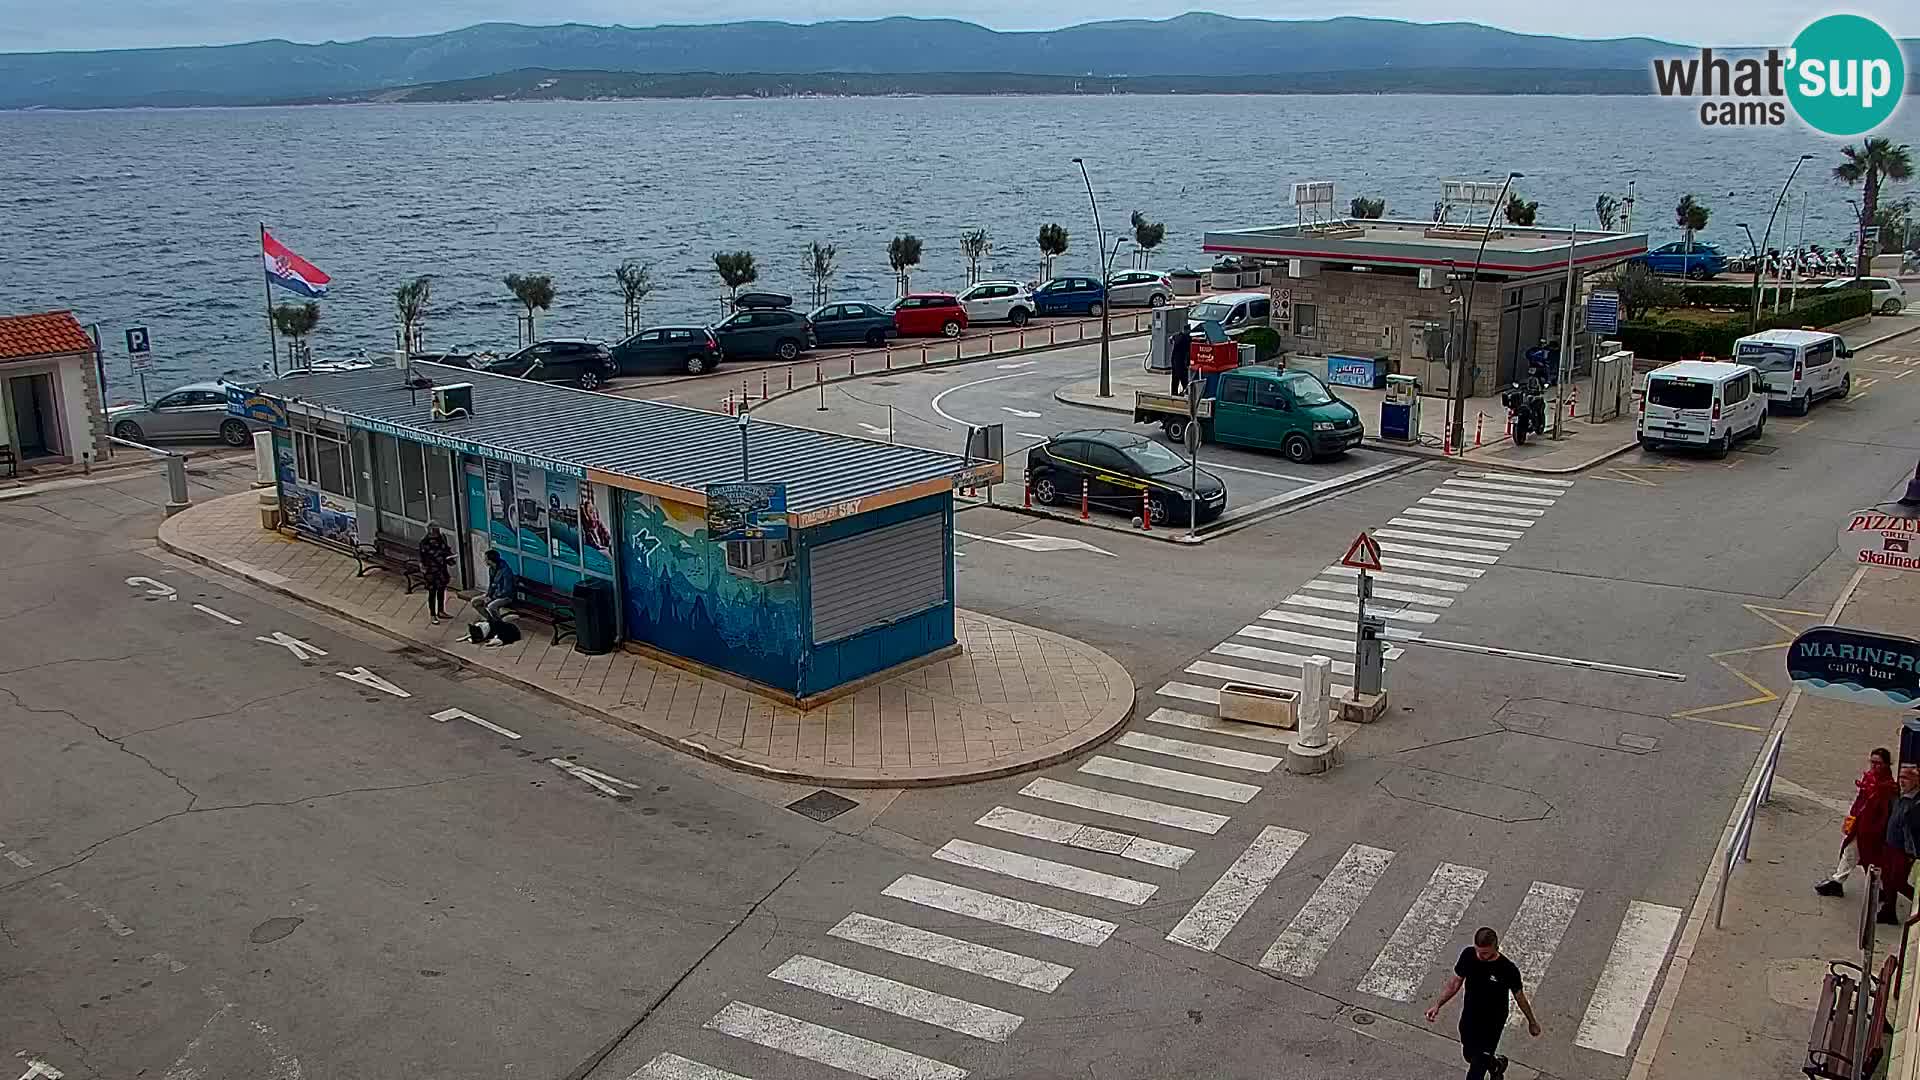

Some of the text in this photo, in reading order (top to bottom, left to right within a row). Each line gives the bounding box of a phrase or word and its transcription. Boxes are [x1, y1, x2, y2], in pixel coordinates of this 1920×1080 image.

[478, 446, 493, 457] BUS
[494, 450, 526, 465] STATION
[528, 456, 554, 471] TICKET
[556, 463, 583, 477] OFFICE
[1881, 530, 1915, 541] GRILL
[1828, 662, 1896, 680] caffe bar
